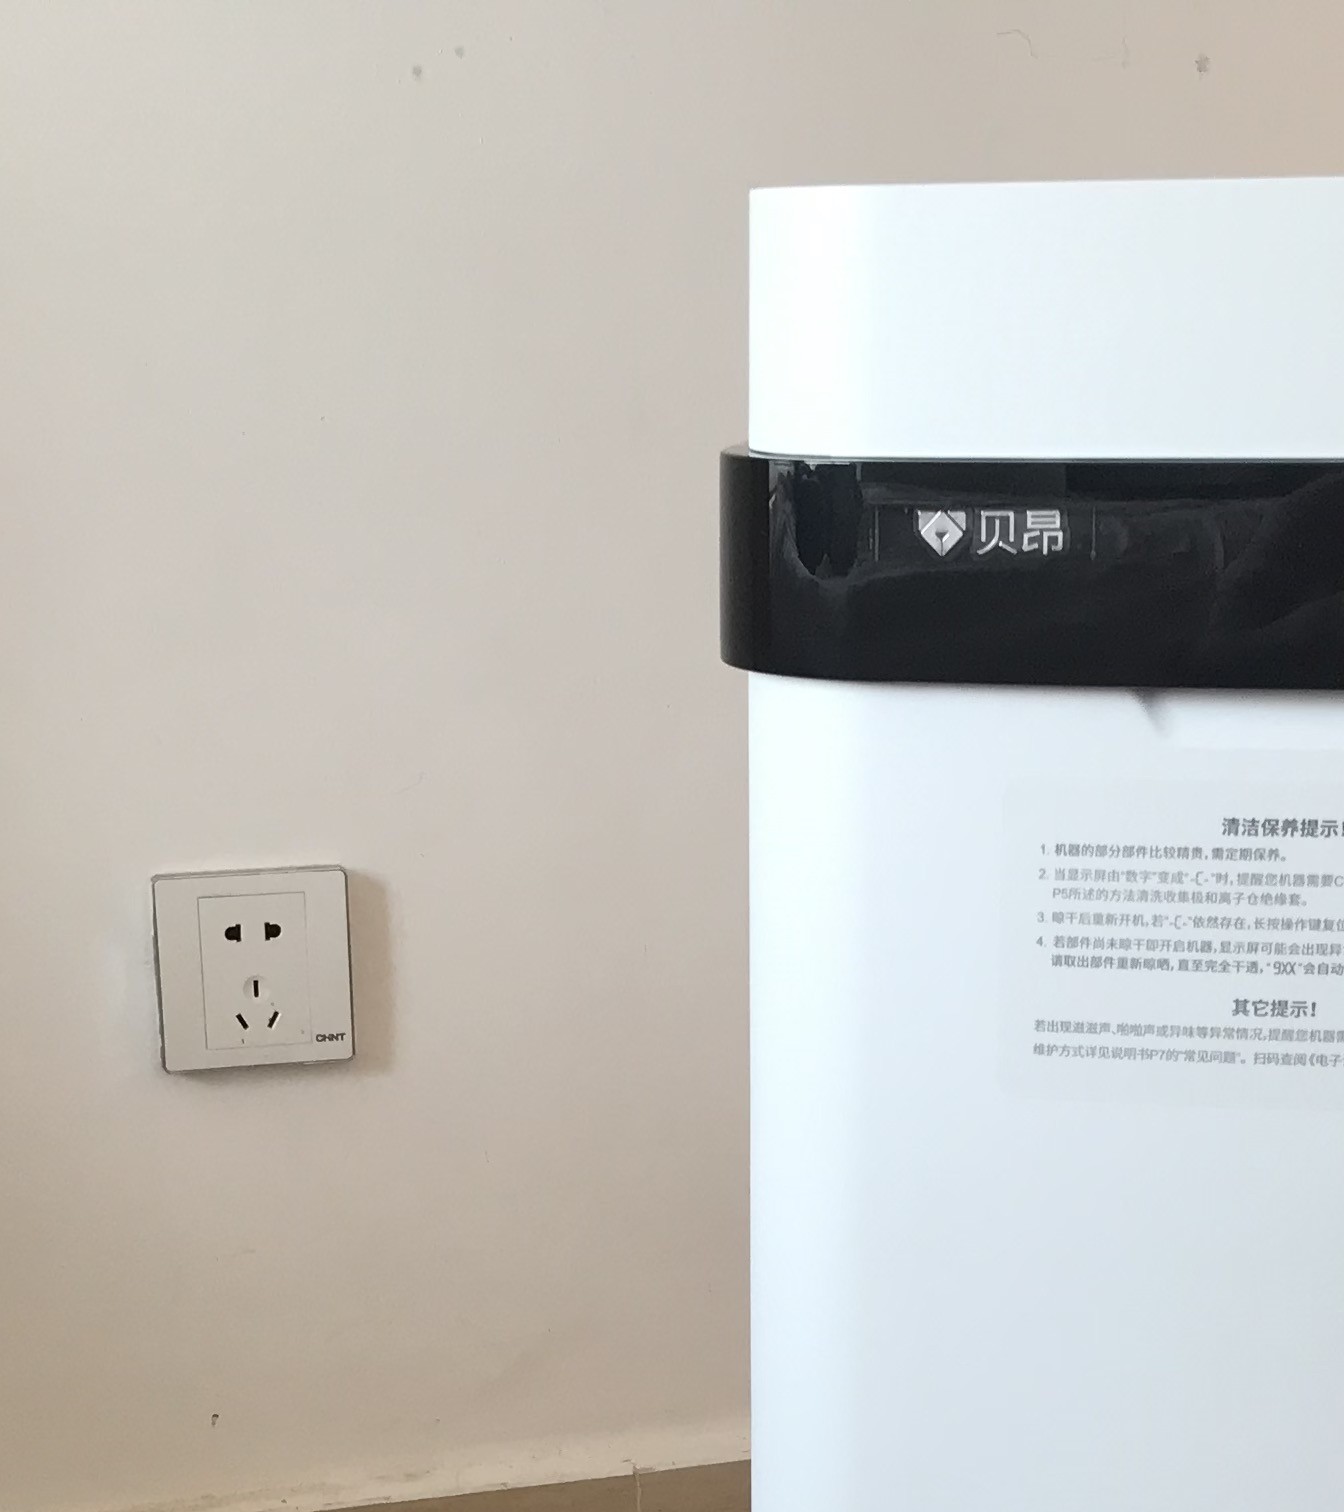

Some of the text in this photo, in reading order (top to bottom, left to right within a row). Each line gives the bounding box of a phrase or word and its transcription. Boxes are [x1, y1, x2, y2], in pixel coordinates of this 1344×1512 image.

[976, 509, 1064, 556] 贝昂
[1231, 998, 1318, 1019] 其它提示！
